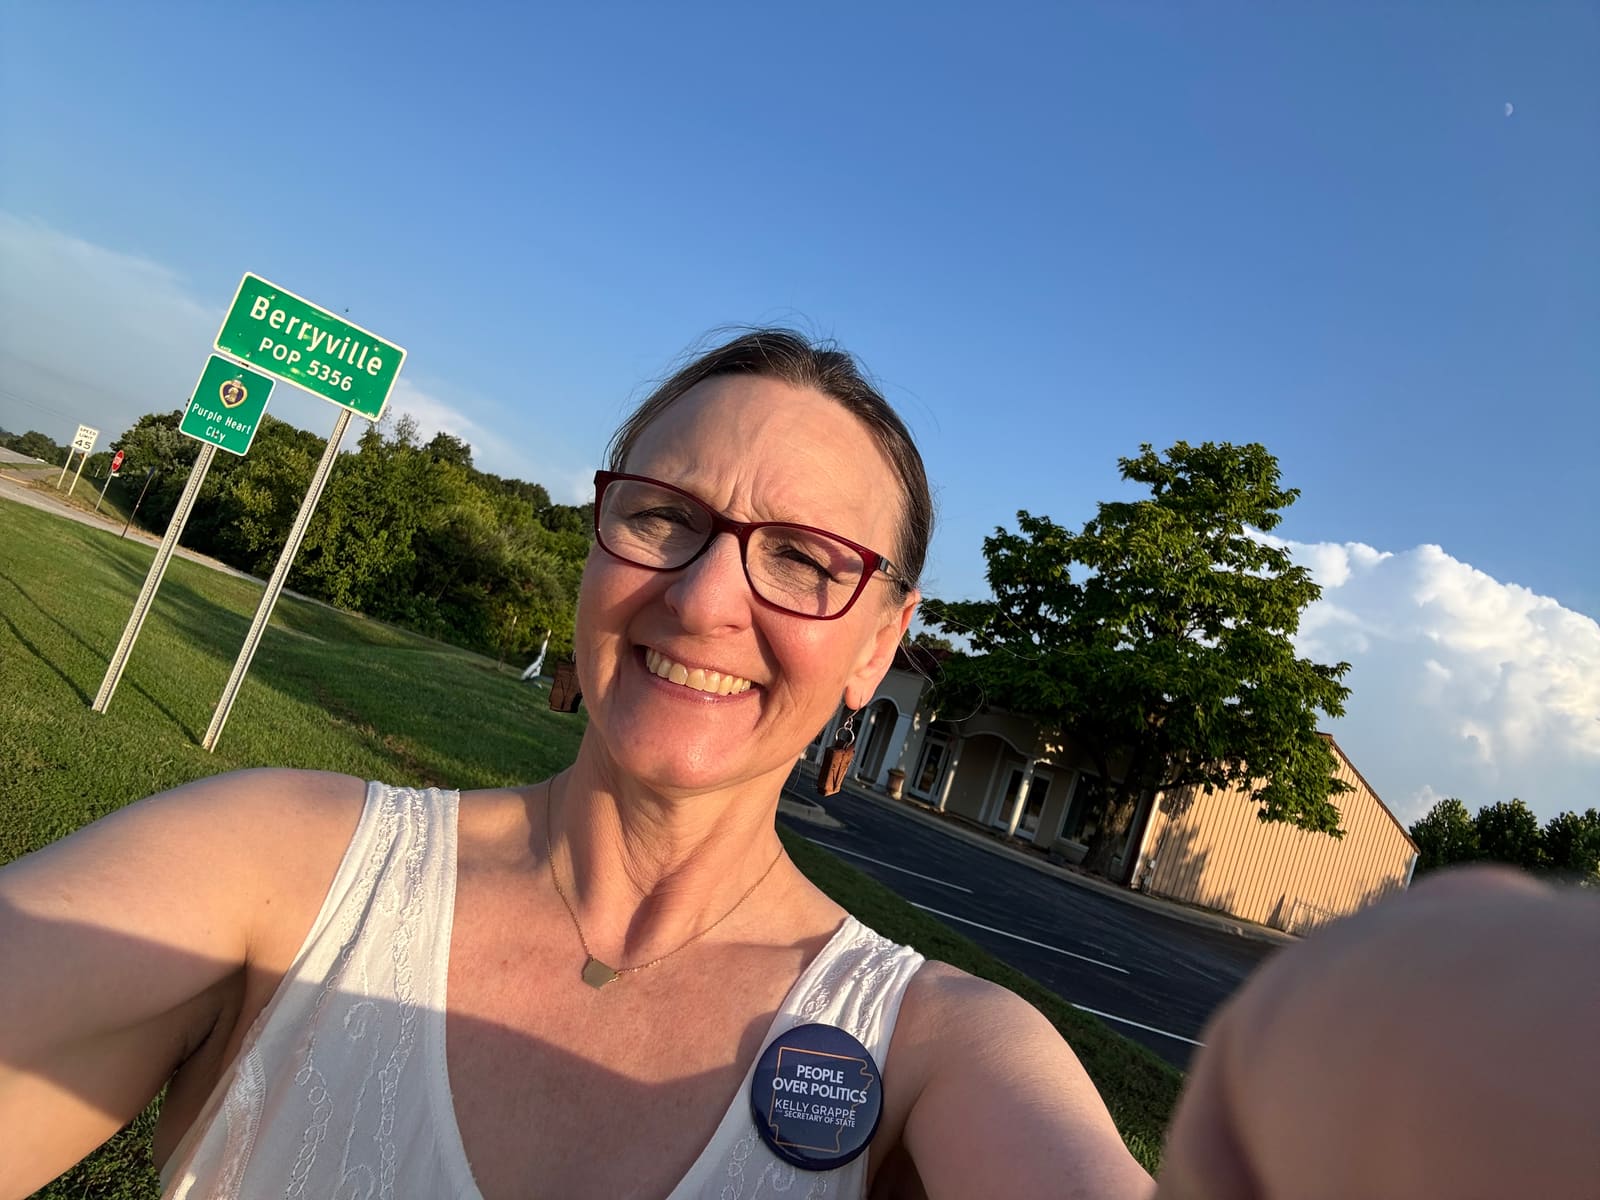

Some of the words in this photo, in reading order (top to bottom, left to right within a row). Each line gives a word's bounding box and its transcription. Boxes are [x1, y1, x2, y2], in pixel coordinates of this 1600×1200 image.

[250, 296, 382, 375] Berryville
[259, 337, 301, 365] POP
[306, 360, 353, 391] 5356
[191, 402, 223, 423] Purple
[224, 415, 252, 435] Heart
[75, 439, 92, 450] 45
[796, 1064, 844, 1084] PEOPLE
[772, 1077, 808, 1095] OVER
[810, 1083, 868, 1104] POLITICS
[775, 1098, 809, 1112] KELLY
[811, 1104, 856, 1120] GRAPPE
[784, 1110, 823, 1123] SECRETARY
[824, 1116, 834, 1125] OF
[835, 1118, 856, 1128] STATE
